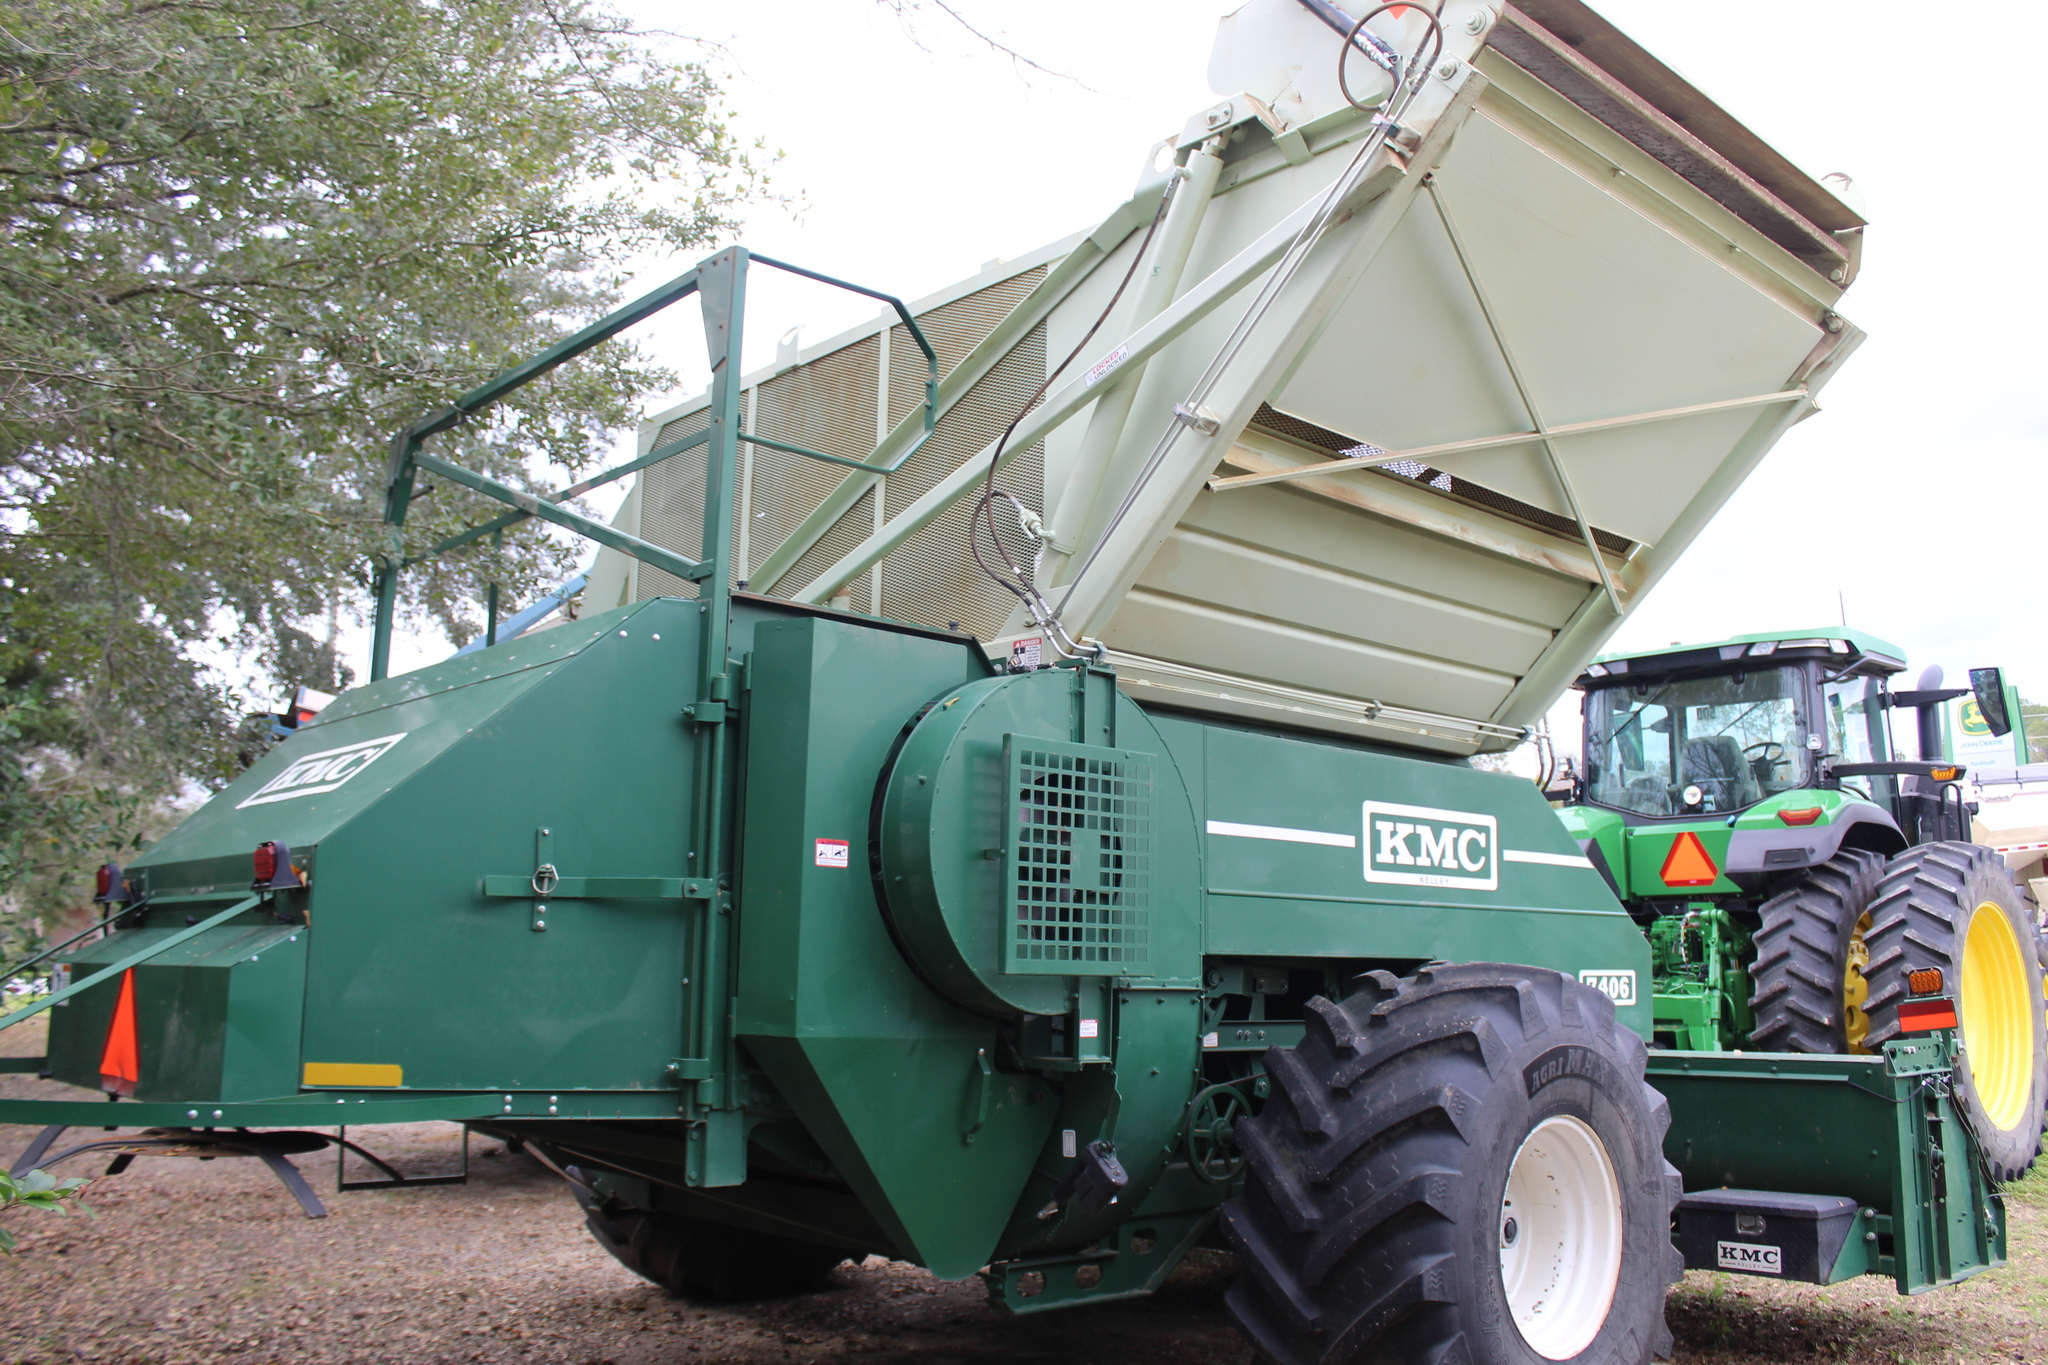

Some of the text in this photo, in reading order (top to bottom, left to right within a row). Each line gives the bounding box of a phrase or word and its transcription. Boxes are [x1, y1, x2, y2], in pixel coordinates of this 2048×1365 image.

[1092, 351, 1120, 375] LOCKED
[1094, 352, 1127, 380] UNLOCKED
[1020, 639, 1040, 647] DANGER
[1961, 739, 2004, 749] JOHN DEERE
[260, 747, 382, 796] KMC
[1970, 759, 1996, 767] SunSouth
[1985, 795, 2010, 803] Unverferth
[1375, 820, 1486, 873] KMC
[1419, 875, 1450, 885] KELLEY
[1586, 976, 1630, 999] 7406
[1719, 1244, 1778, 1265] KMC
